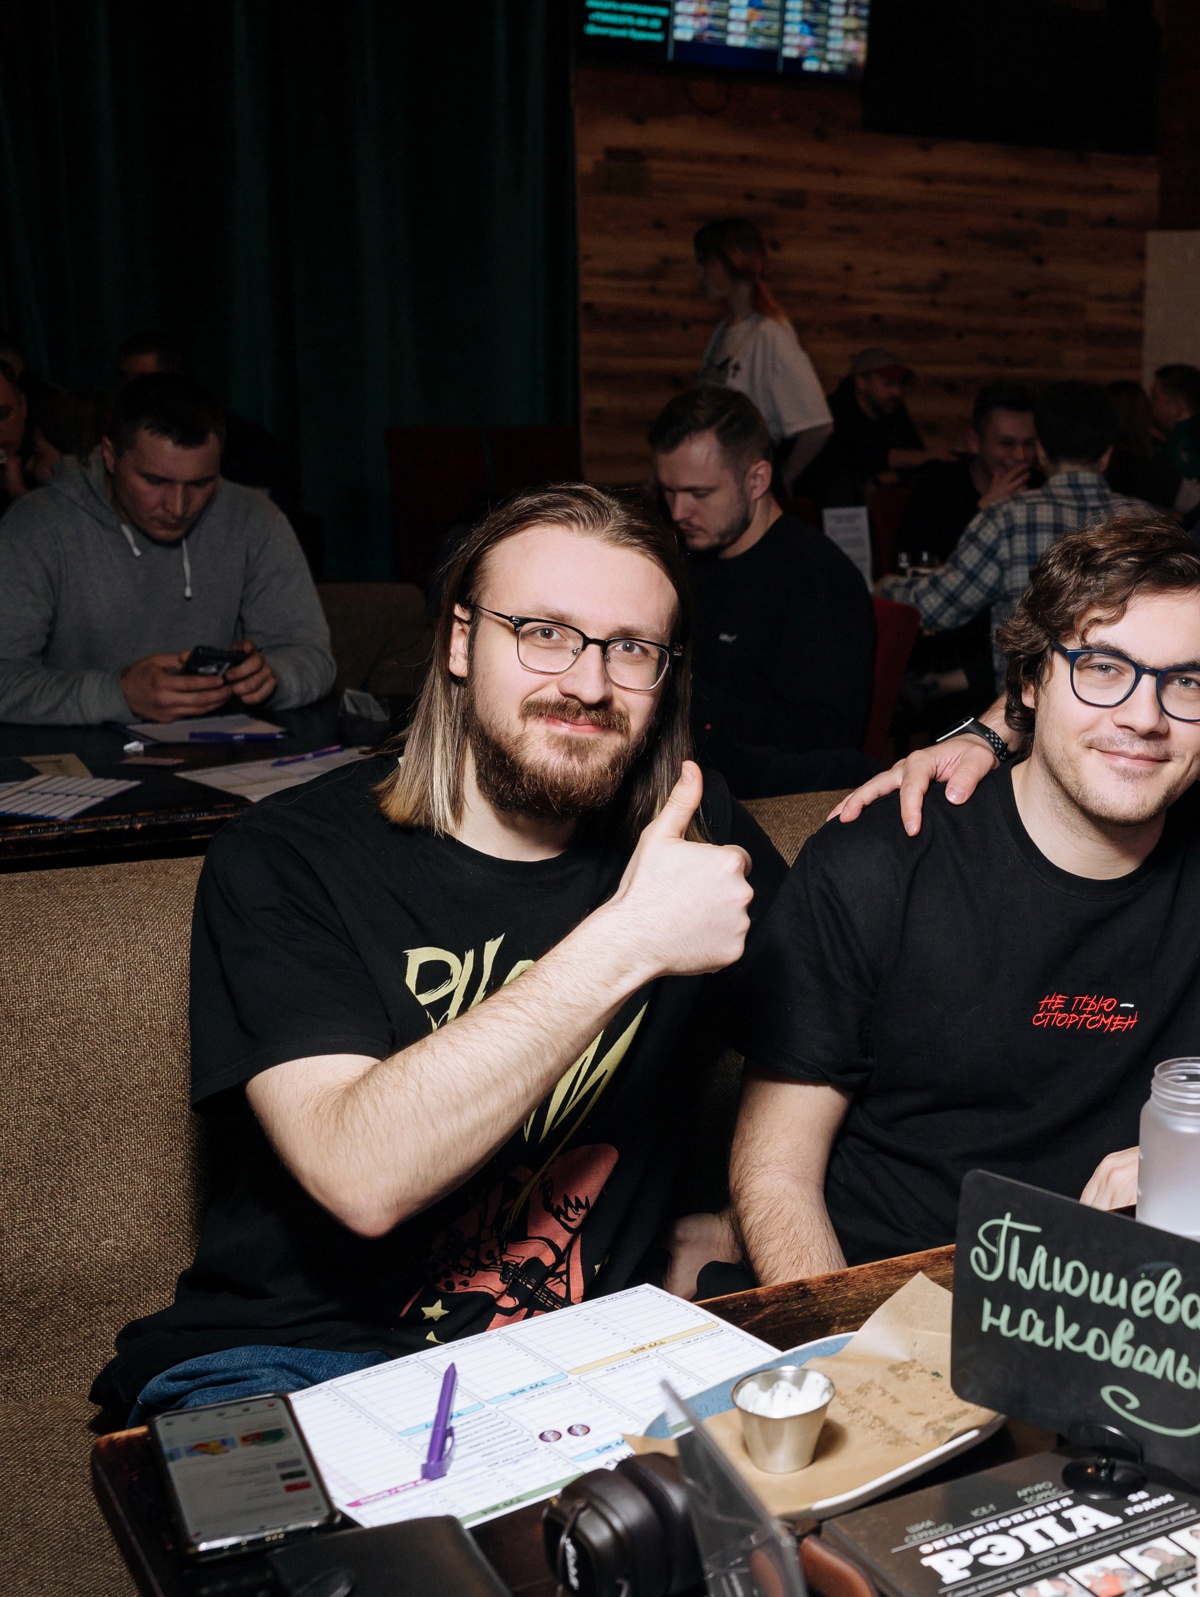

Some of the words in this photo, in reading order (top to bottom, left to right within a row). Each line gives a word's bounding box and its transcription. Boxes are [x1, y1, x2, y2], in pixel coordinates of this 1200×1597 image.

[1032, 1010, 1138, 1033] СПОРТСМЕН
[1039, 992, 1069, 1012] НЕ
[1071, 994, 1117, 1013] ПЬЮ
[919, 1496, 1074, 1555] ЭНЦИКЛОПЕДИЯ
[919, 1504, 1123, 1585] РЭПА
